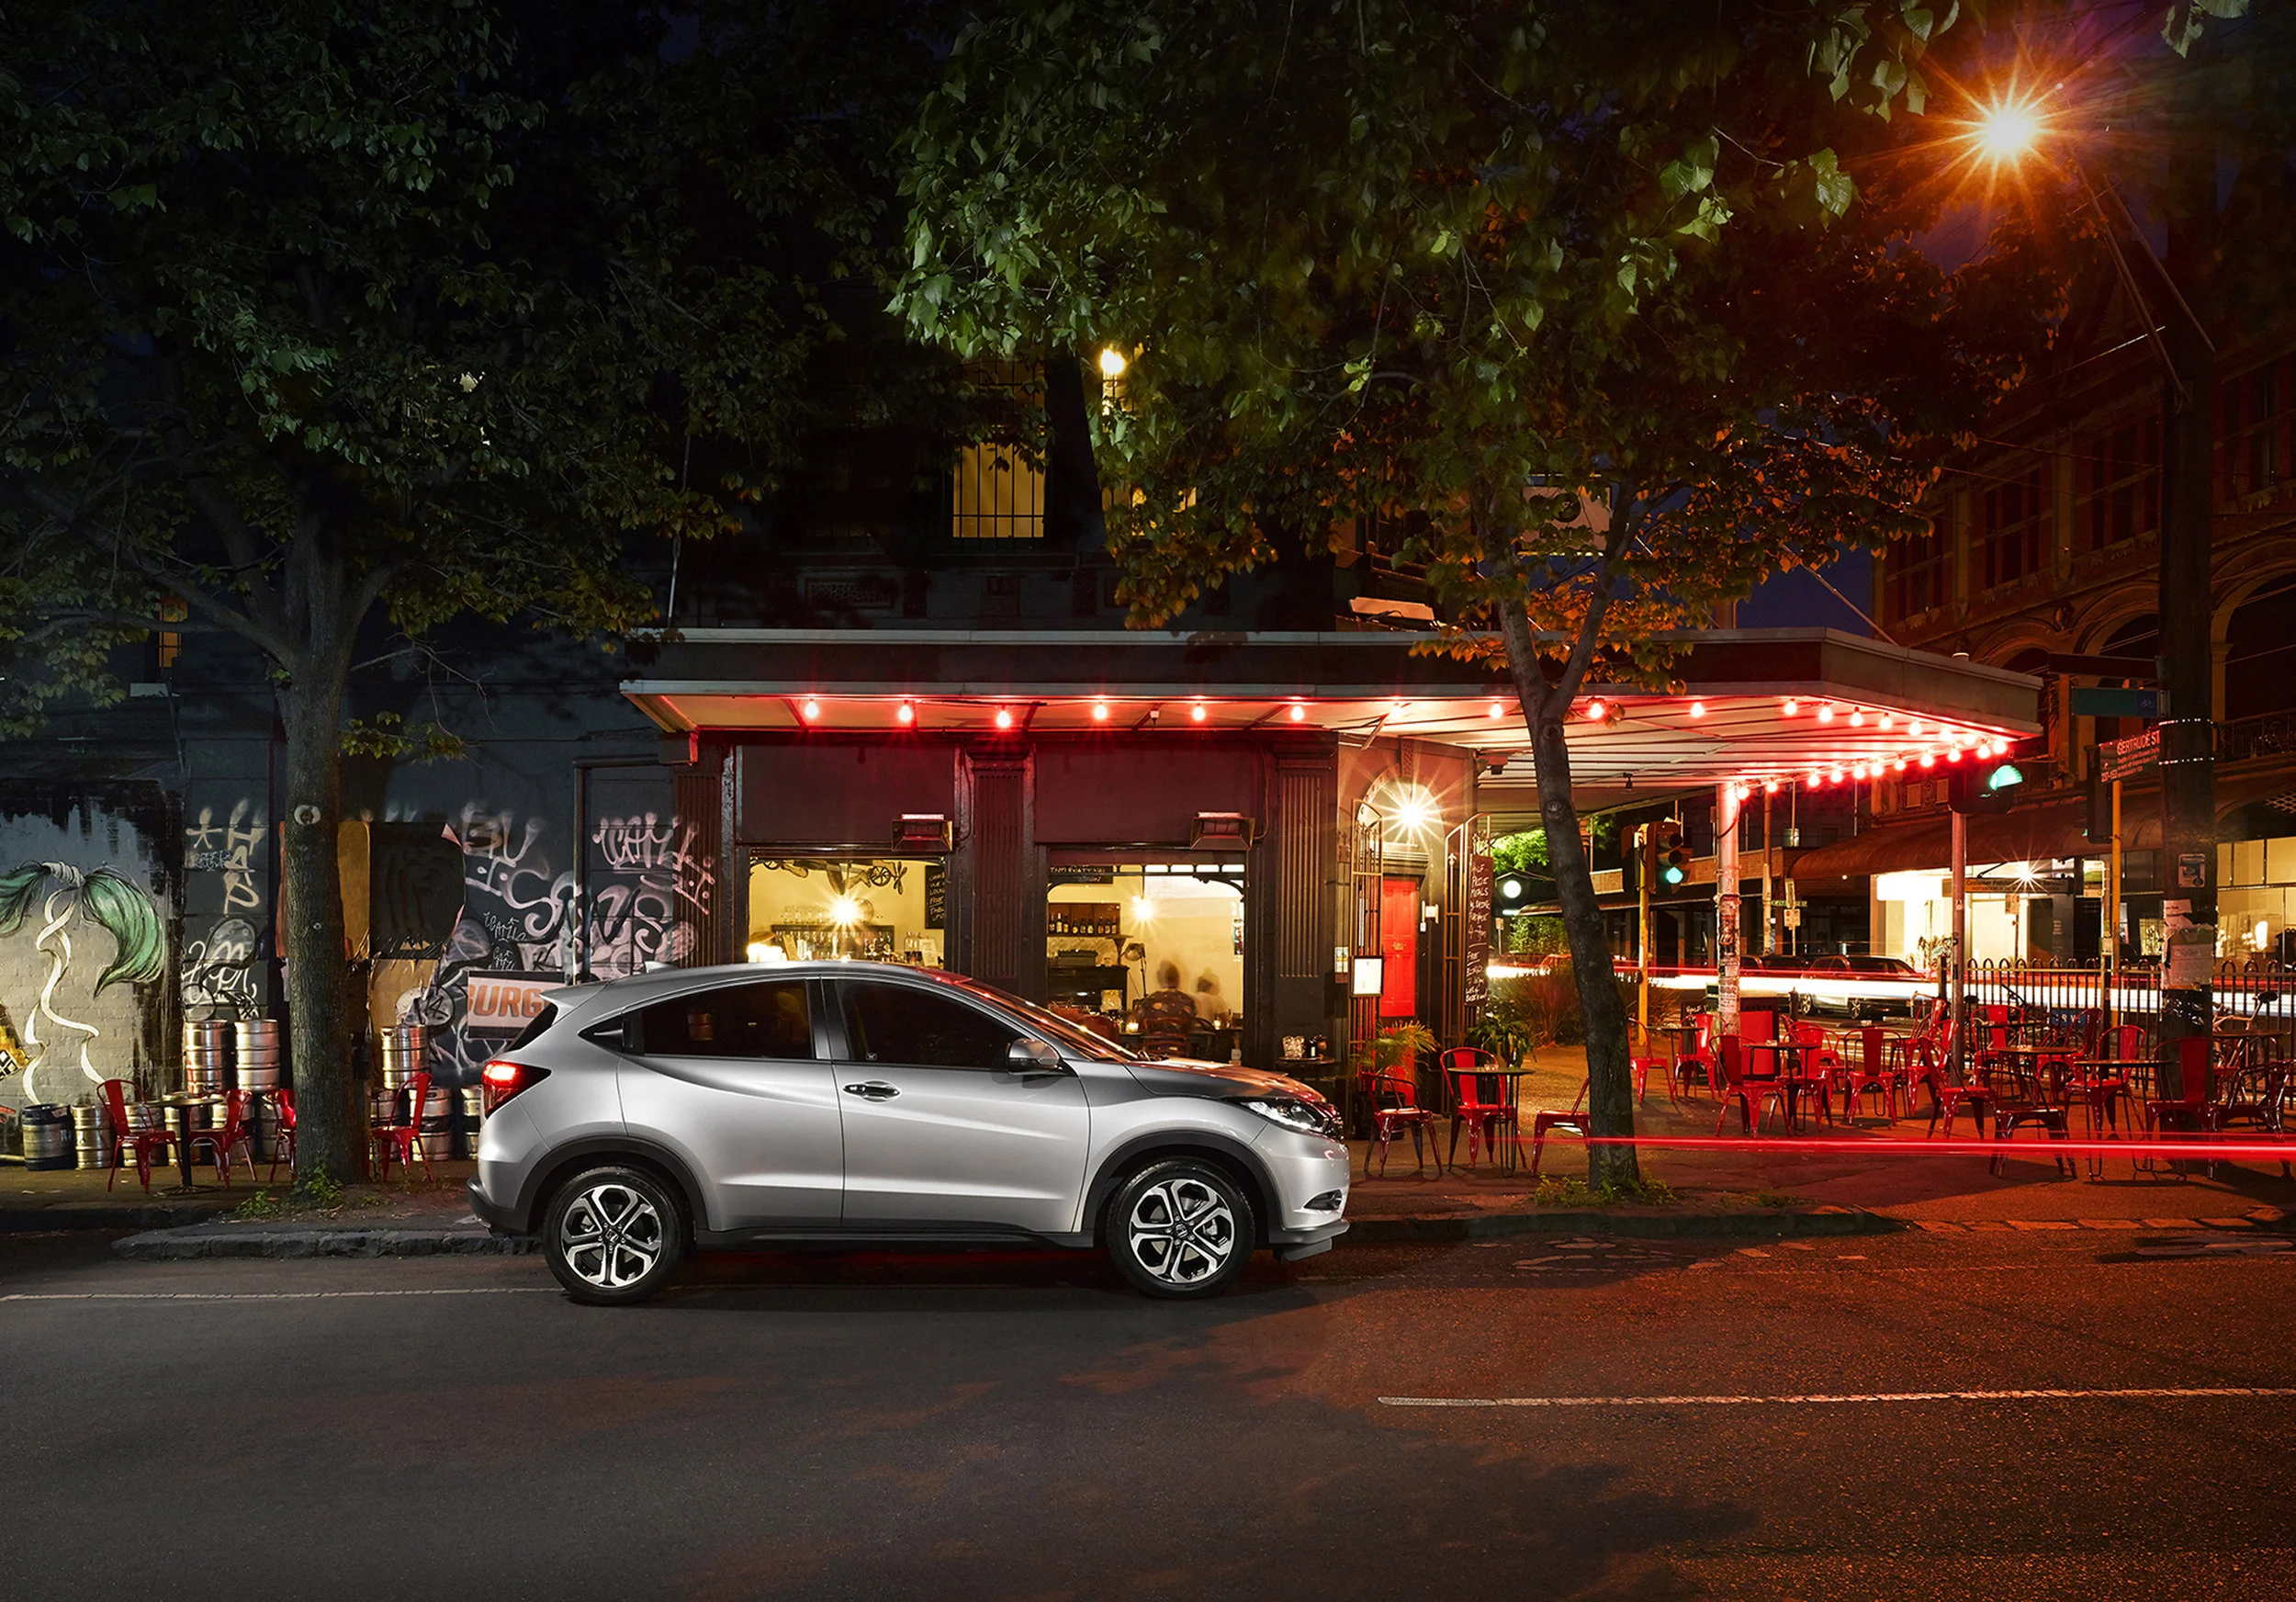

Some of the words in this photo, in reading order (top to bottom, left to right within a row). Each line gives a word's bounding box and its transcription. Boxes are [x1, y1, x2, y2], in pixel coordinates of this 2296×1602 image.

[2117, 733, 2151, 756] GERTRUDE
[2151, 730, 2161, 746] ST
[468, 985, 551, 1018] URG
